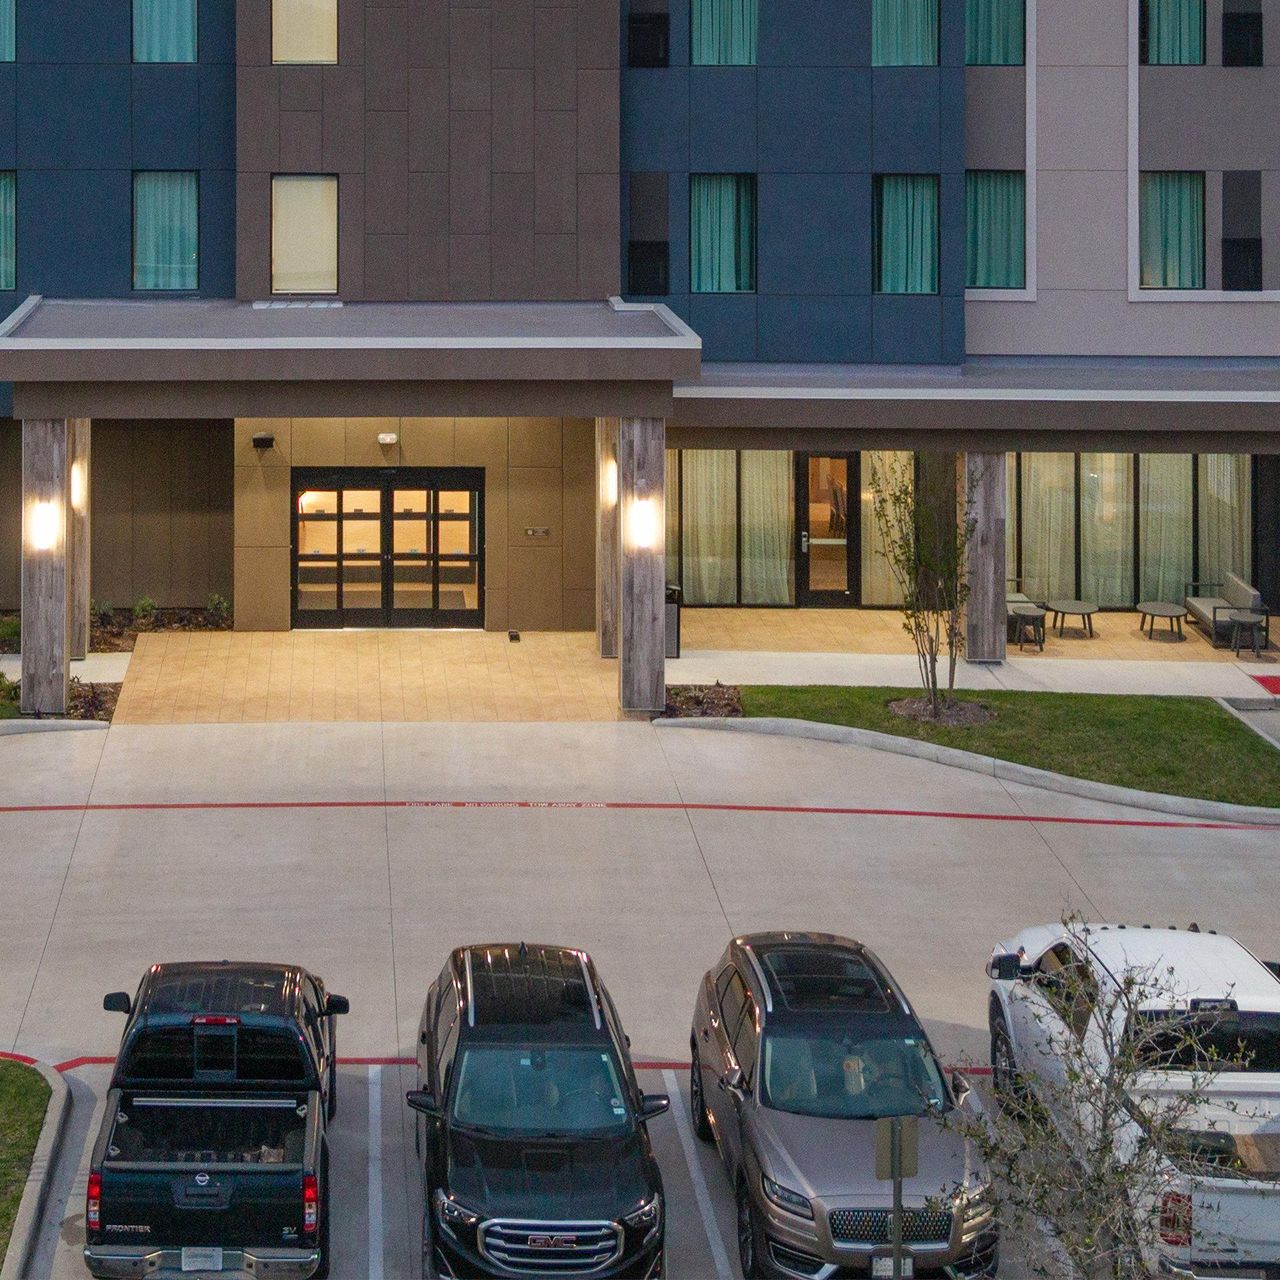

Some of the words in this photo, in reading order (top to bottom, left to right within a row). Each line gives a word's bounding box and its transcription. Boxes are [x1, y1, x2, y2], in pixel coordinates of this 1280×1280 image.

[105, 1224, 151, 1233] FRONTIER
[282, 1226, 297, 1234] SV
[527, 1235, 577, 1249] GMC
